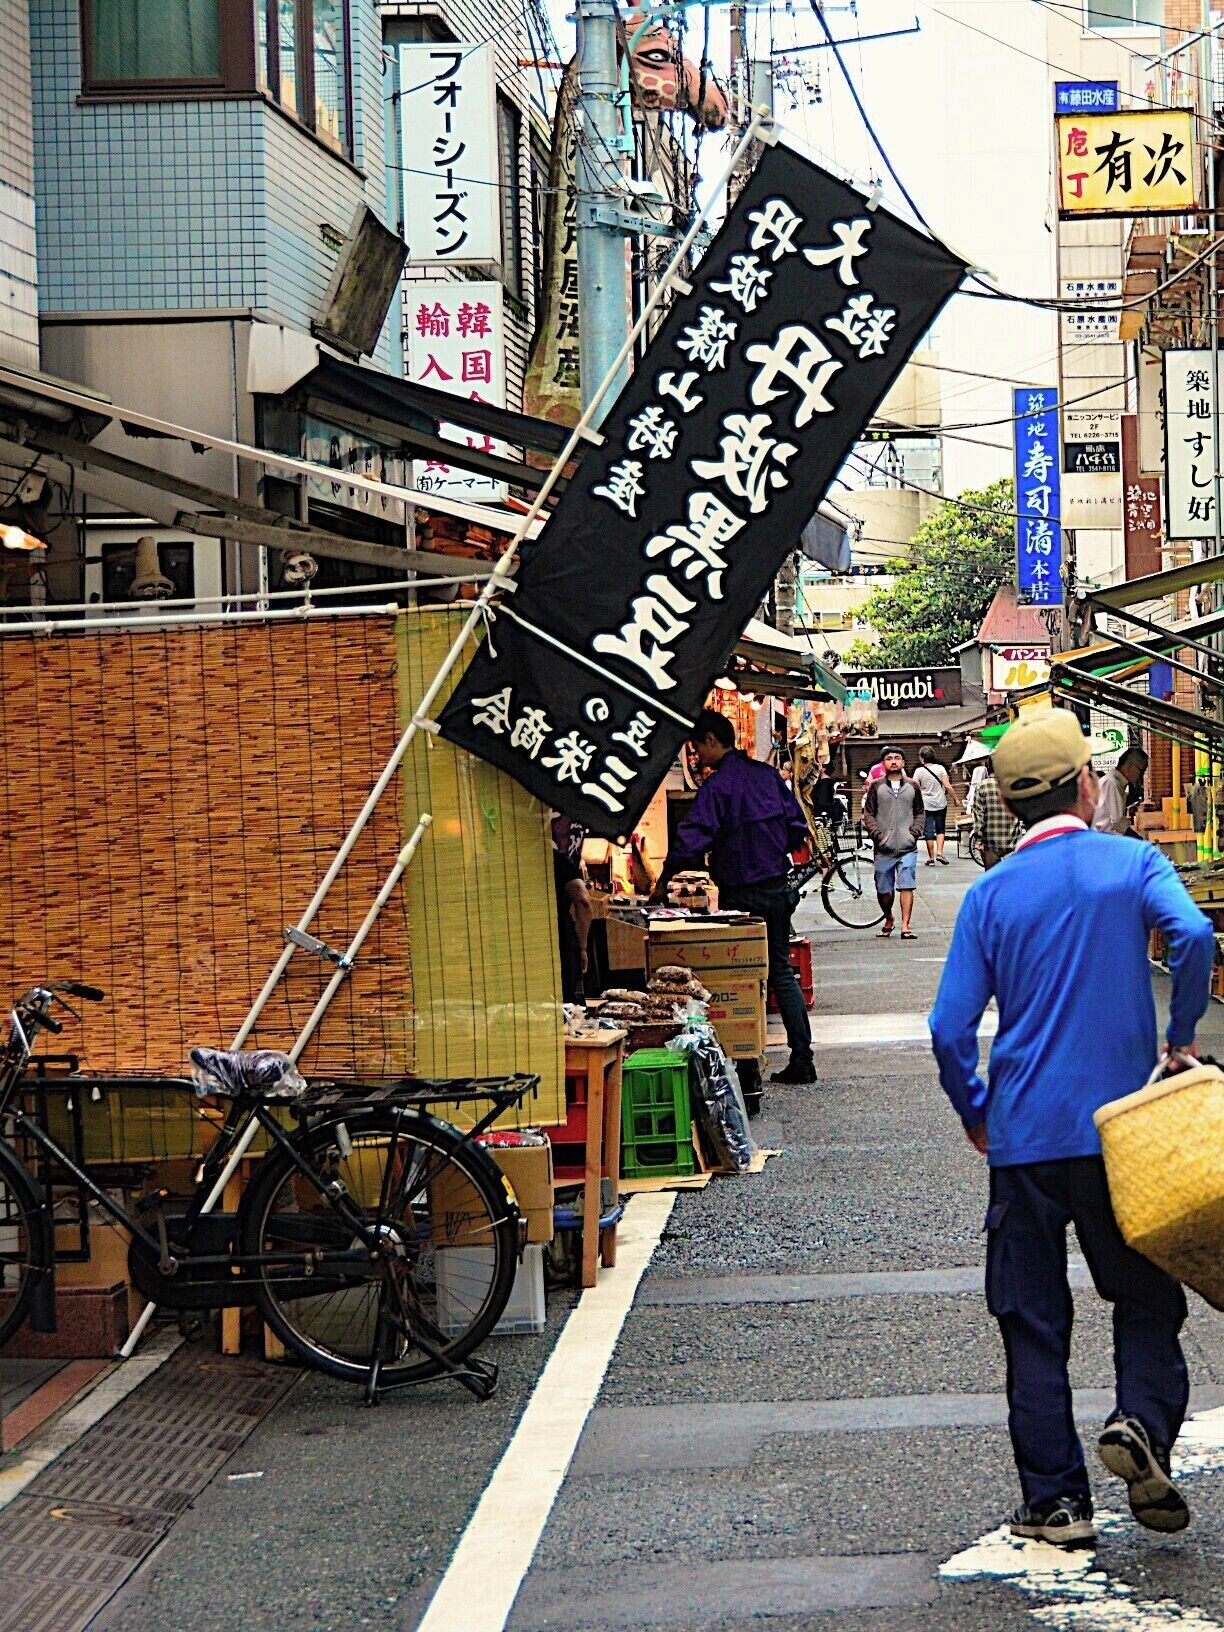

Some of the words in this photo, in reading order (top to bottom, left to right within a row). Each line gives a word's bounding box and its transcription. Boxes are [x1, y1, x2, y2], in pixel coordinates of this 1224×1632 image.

[429, 52, 469, 256] フォーシーズン
[1066, 127, 1089, 198] 庖丁
[1093, 130, 1187, 195] 有次
[1183, 370, 1215, 521] 築地すし好
[1010, 649, 1050, 660] パン工
[856, 675, 935, 707] Miyabi
